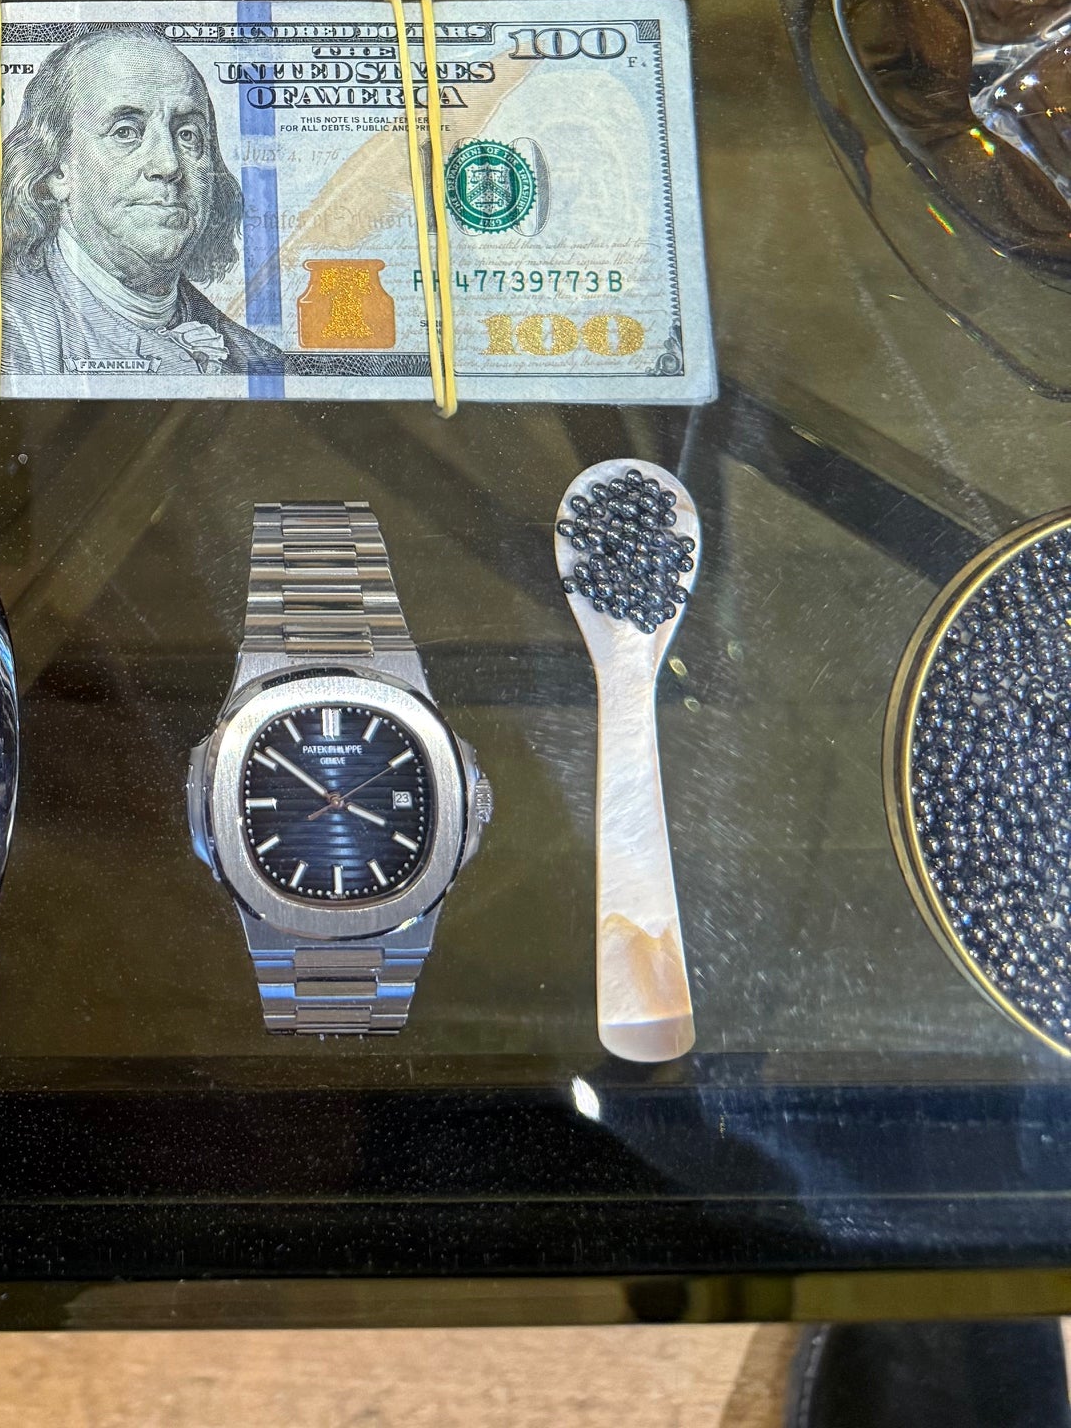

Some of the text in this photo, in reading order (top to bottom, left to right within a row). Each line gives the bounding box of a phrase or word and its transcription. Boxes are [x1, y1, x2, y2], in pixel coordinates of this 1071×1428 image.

[165, 25, 218, 38] ONE
[224, 25, 355, 38] HUNDRED
[509, 27, 627, 60] 100
[312, 46, 396, 59] THE
[0, 63, 34, 75] OTE
[214, 61, 354, 84] UNITED
[247, 86, 468, 109] OF AMERCA
[300, 116, 429, 124] THIS NOTE IS LEGAL TENER
[280, 124, 299, 132] FOR
[301, 124, 319, 132] ALL
[356, 124, 389, 132] PUBLIC
[416, 124, 451, 132] PRITE
[486, 146, 500, 155] OF
[478, 313, 645, 357] 100
[80, 360, 145, 370] FRANKLIN
[302, 745, 327, 754] PATEK
[395, 793, 410, 804] 23
